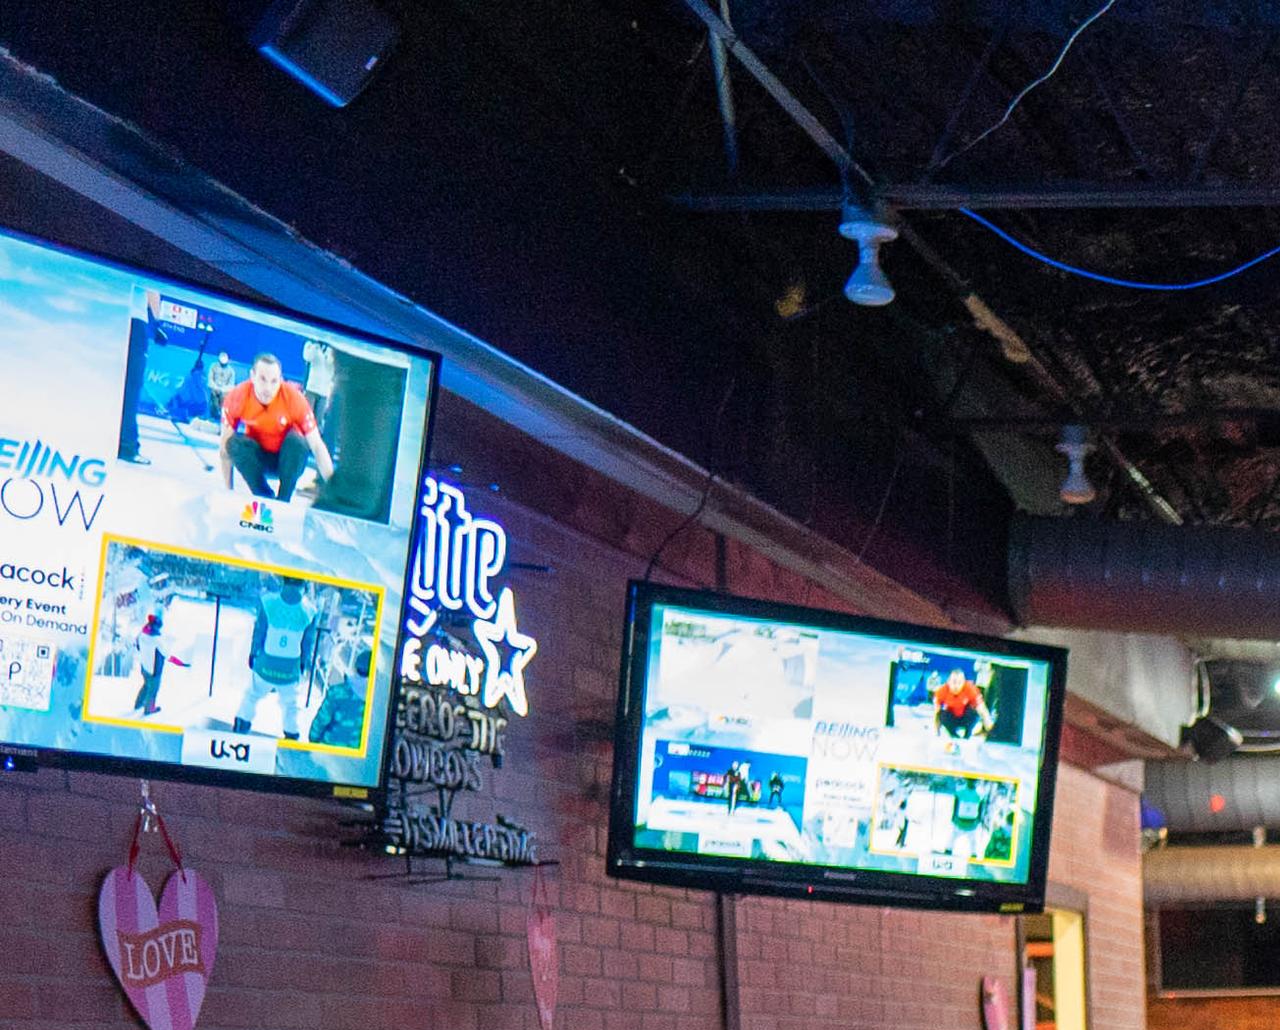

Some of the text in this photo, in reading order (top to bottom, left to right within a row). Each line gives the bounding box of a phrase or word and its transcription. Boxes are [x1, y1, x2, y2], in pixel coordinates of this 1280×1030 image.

[0, 436, 107, 488] EIJING
[0, 478, 105, 532] OW
[0, 562, 75, 591] acock
[409, 476, 507, 637] ite
[0, 595, 67, 615] ery Event
[2, 612, 88, 636] On Demand
[811, 736, 879, 762] NOW
[814, 720, 880, 742] BEIJING
[394, 738, 484, 793] OWBOYS
[123, 928, 199, 981] LOVE
